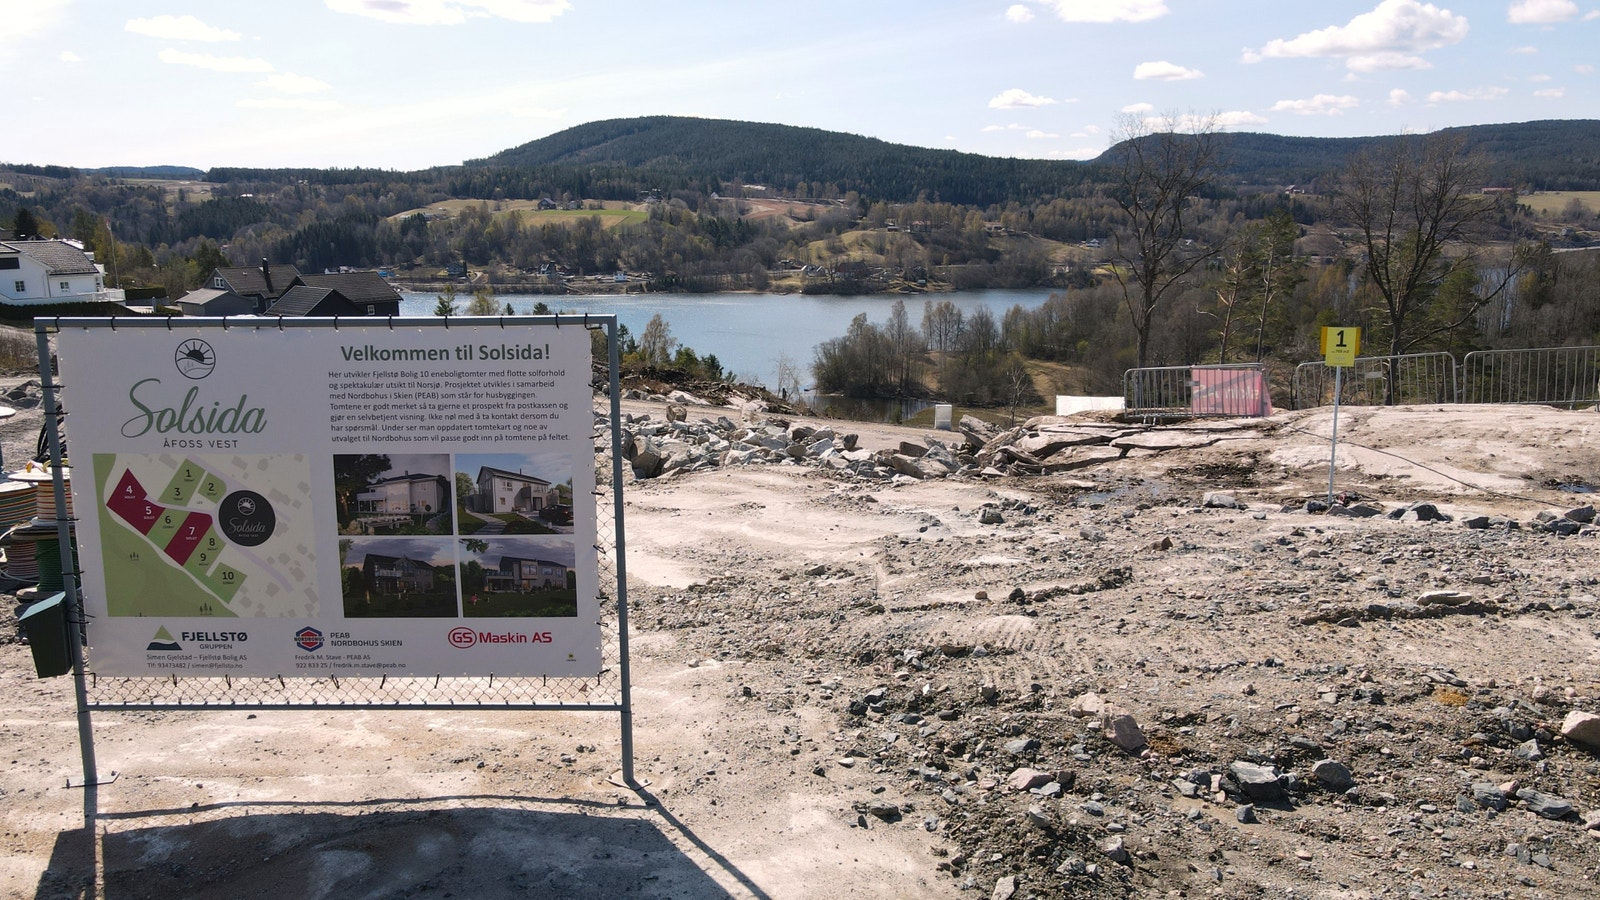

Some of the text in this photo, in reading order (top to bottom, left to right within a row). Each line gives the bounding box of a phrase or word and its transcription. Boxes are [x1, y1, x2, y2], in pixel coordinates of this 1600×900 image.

[1336, 330, 1347, 347] 1
[340, 343, 549, 361] Velkommen til Solsida!
[343, 370, 371, 378] utvikler
[372, 370, 399, 379] Fjellstø
[400, 370, 418, 379] Bolig
[430, 370, 487, 379] eneboligtomter
[506, 369, 527, 377] flotte
[339, 381, 384, 390] spektakulær
[416, 381, 442, 390] Norsjø.
[444, 380, 481, 390] Prosjektet
[482, 380, 511, 388] utvikles
[516, 380, 555, 388] samarbeid
[329, 392, 346, 400] med
[393, 391, 413, 399] Skien
[414, 391, 439, 400] (PEAB)
[457, 391, 472, 399] står
[473, 391, 484, 399] for
[485, 391, 538, 400] husbyggingen.
[120, 377, 268, 439] Solsida
[329, 402, 362, 410] Tomtene
[372, 402, 390, 411] godt
[391, 402, 417, 410] merket
[471, 402, 504, 410] prospekt
[505, 401, 515, 409] fra
[517, 401, 557, 410] postkassen
[330, 414, 345, 422] gjør
[357, 413, 398, 422] selvbetjent
[399, 413, 426, 422] visning.
[475, 412, 480, 420] å
[491, 412, 518, 420] kontakt
[344, 423, 379, 432] spørsmål.
[436, 423, 473, 432] oppdatert
[512, 424, 522, 432] og
[163, 437, 238, 448] ÅFOSS VEST
[331, 435, 361, 443] utvalget
[362, 434, 370, 442] til
[371, 434, 412, 442] Nordbohus
[462, 434, 479, 443] godt
[494, 433, 503, 442] på
[538, 433, 547, 441] på
[186, 469, 192, 478] 1
[126, 485, 133, 494] 4
[174, 488, 181, 496] 3
[208, 483, 215, 492] 2
[145, 506, 152, 515] 5
[165, 516, 172, 524] 6
[228, 517, 266, 534] Solsida
[189, 527, 196, 536] 7
[209, 538, 216, 547] 8
[200, 553, 207, 562] 9
[222, 572, 235, 580] 10
[181, 631, 248, 642] FJELLSTØ
[452, 632, 552, 643] GS Maskin AS
